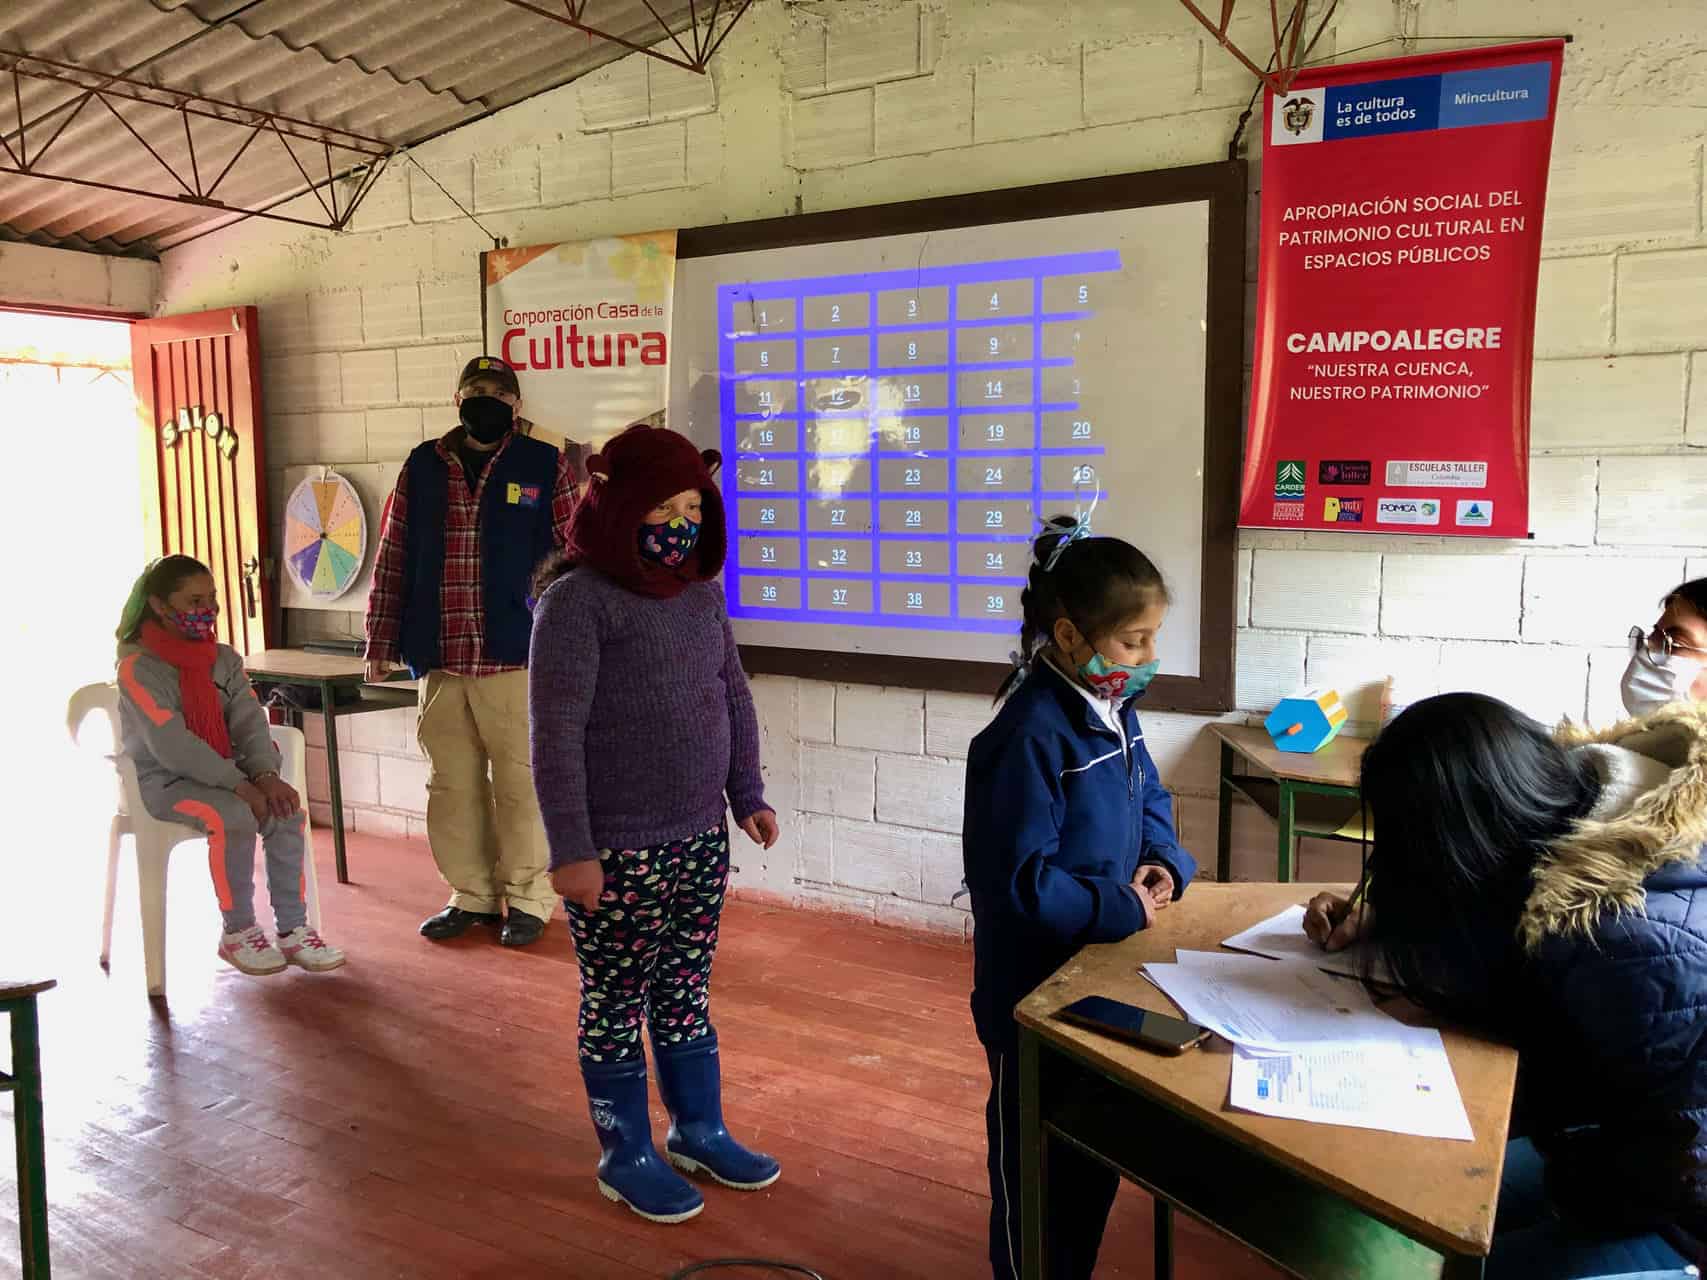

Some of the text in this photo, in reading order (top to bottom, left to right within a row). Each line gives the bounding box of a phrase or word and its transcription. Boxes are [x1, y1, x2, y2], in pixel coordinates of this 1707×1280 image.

[1454, 88, 1529, 105] Mincultura
[1336, 96, 1405, 114] La cultura
[1336, 107, 1416, 127] es de todos
[1282, 190, 1522, 221] APROPIACIÓN SOCIAL DEL
[1279, 216, 1525, 246] PATRIMONIO CULTURAL EN
[1304, 245, 1490, 270] ESPACIOS PÚBLICOS
[989, 292, 1000, 310] 4
[1078, 286, 1088, 303] 5
[503, 304, 594, 326] Corporación
[597, 302, 639, 319] Casa
[832, 305, 840, 321] 2
[907, 300, 916, 316] 3
[760, 312, 768, 326] 1
[501, 324, 668, 371] Cultura
[989, 337, 999, 354] 9
[1286, 327, 1502, 353] CAMPOALEGRE
[760, 351, 769, 366] 6
[832, 347, 840, 363] 7
[908, 344, 917, 359] 8
[1394, 361, 1473, 377] CUENCA,
[904, 385, 920, 402] 13
[984, 381, 1003, 398] 14
[1290, 386, 1366, 400] NUESTRO
[758, 391, 771, 406] 11
[162, 405, 236, 460] SALON
[759, 430, 773, 445] 16
[905, 427, 920, 443] 18
[986, 424, 1005, 441] 19
[1072, 422, 1090, 439] 20
[984, 468, 1002, 484] 24
[1409, 463, 1485, 473] ESCUELAS TALLER
[759, 470, 774, 484] 21
[905, 469, 921, 485] 23
[1380, 503, 1418, 512] POMCA
[760, 509, 775, 523] 26
[831, 509, 846, 525] 27
[905, 511, 921, 527] 28
[985, 511, 1003, 527] 29
[761, 547, 776, 562] 31
[832, 550, 847, 565] 32
[906, 551, 922, 567] 33
[986, 553, 1003, 569] 34
[762, 586, 776, 601] 36
[832, 589, 848, 605] 37
[907, 592, 923, 608] 38
[986, 596, 1005, 612] 39
